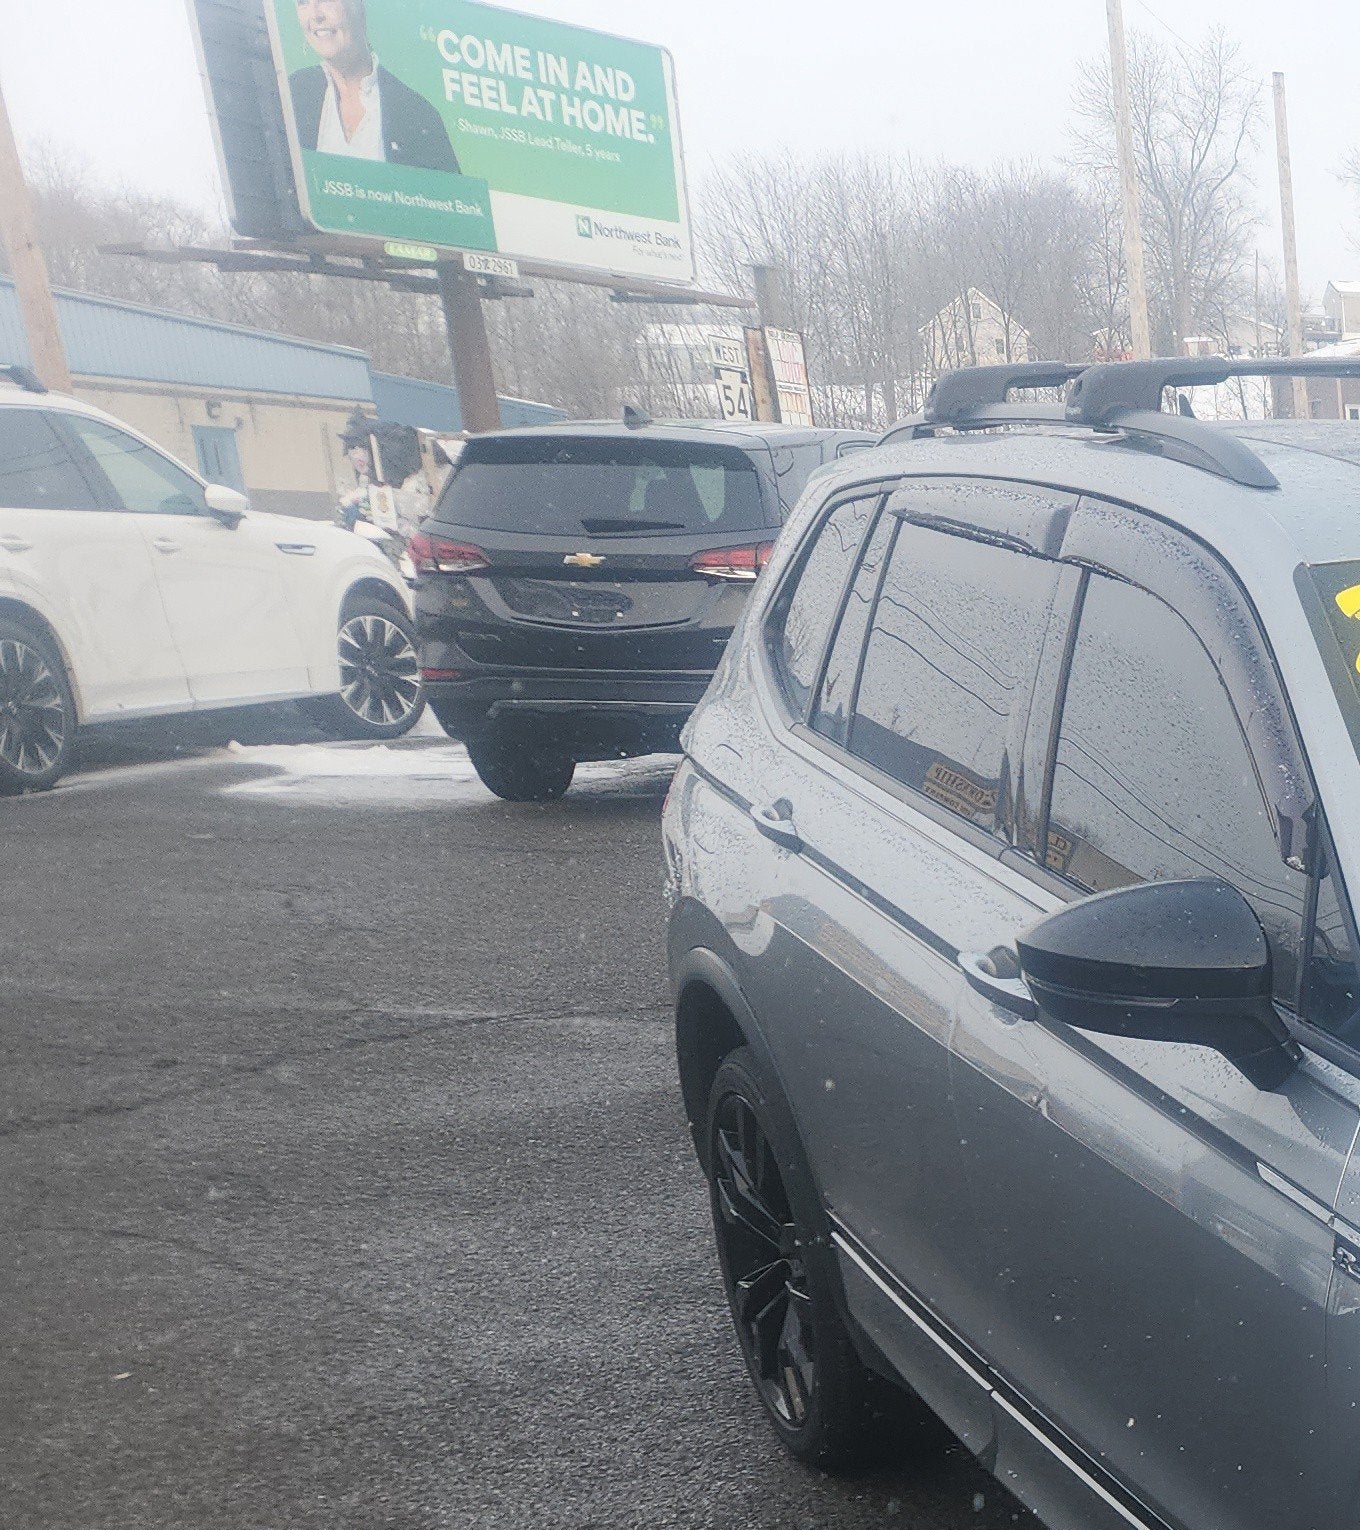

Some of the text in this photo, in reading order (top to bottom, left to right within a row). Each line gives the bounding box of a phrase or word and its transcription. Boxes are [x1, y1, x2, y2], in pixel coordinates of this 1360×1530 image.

[537, 51, 569, 88] IN
[574, 60, 636, 102] AND
[442, 68, 517, 115] FEEL
[521, 85, 556, 122] AT
[457, 118, 498, 139] Shawn,
[500, 128, 526, 146] JSSB
[528, 134, 554, 150] Lead
[585, 144, 592, 157] 5
[595, 148, 621, 163] years
[323, 180, 484, 216] JSSB is now Northwest Bank
[593, 220, 653, 245] Northwest
[655, 232, 682, 249] Bank
[713, 341, 740, 363] WEST
[723, 385, 749, 418] 54
